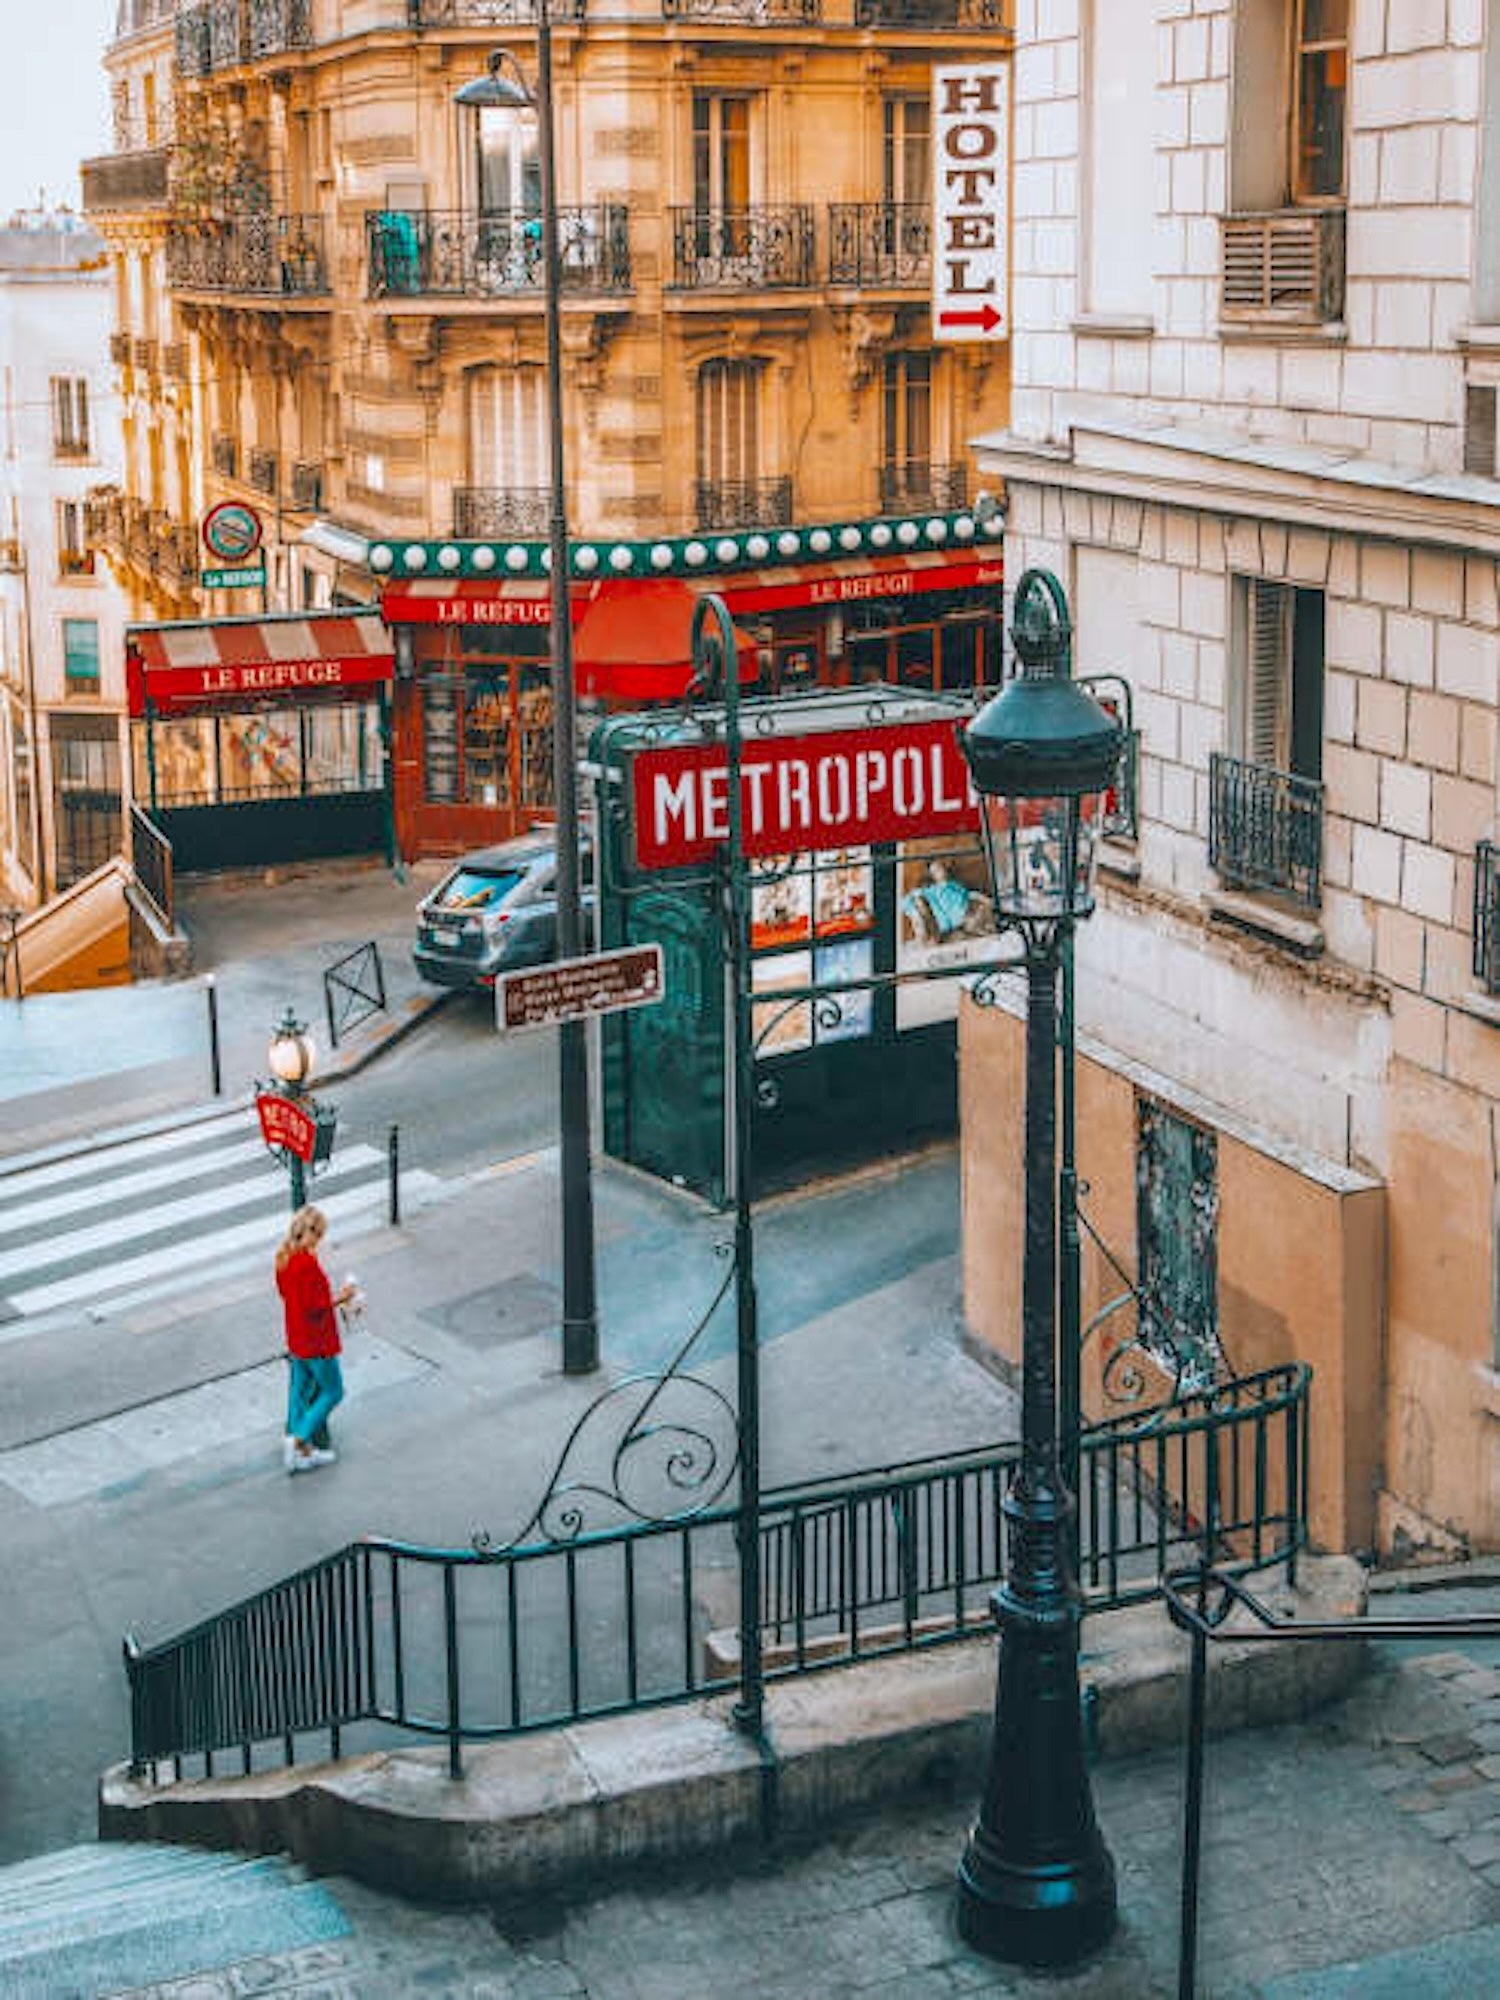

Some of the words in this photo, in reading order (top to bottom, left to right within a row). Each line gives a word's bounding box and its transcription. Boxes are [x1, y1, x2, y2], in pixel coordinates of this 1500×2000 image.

[941, 76, 999, 294] HOTEL
[810, 582, 838, 602] LE
[437, 600, 467, 622] LE
[473, 600, 552, 622] REFUG
[201, 669, 237, 692] LE
[241, 661, 342, 689] REFUGE
[654, 741, 986, 845] METROPOL
